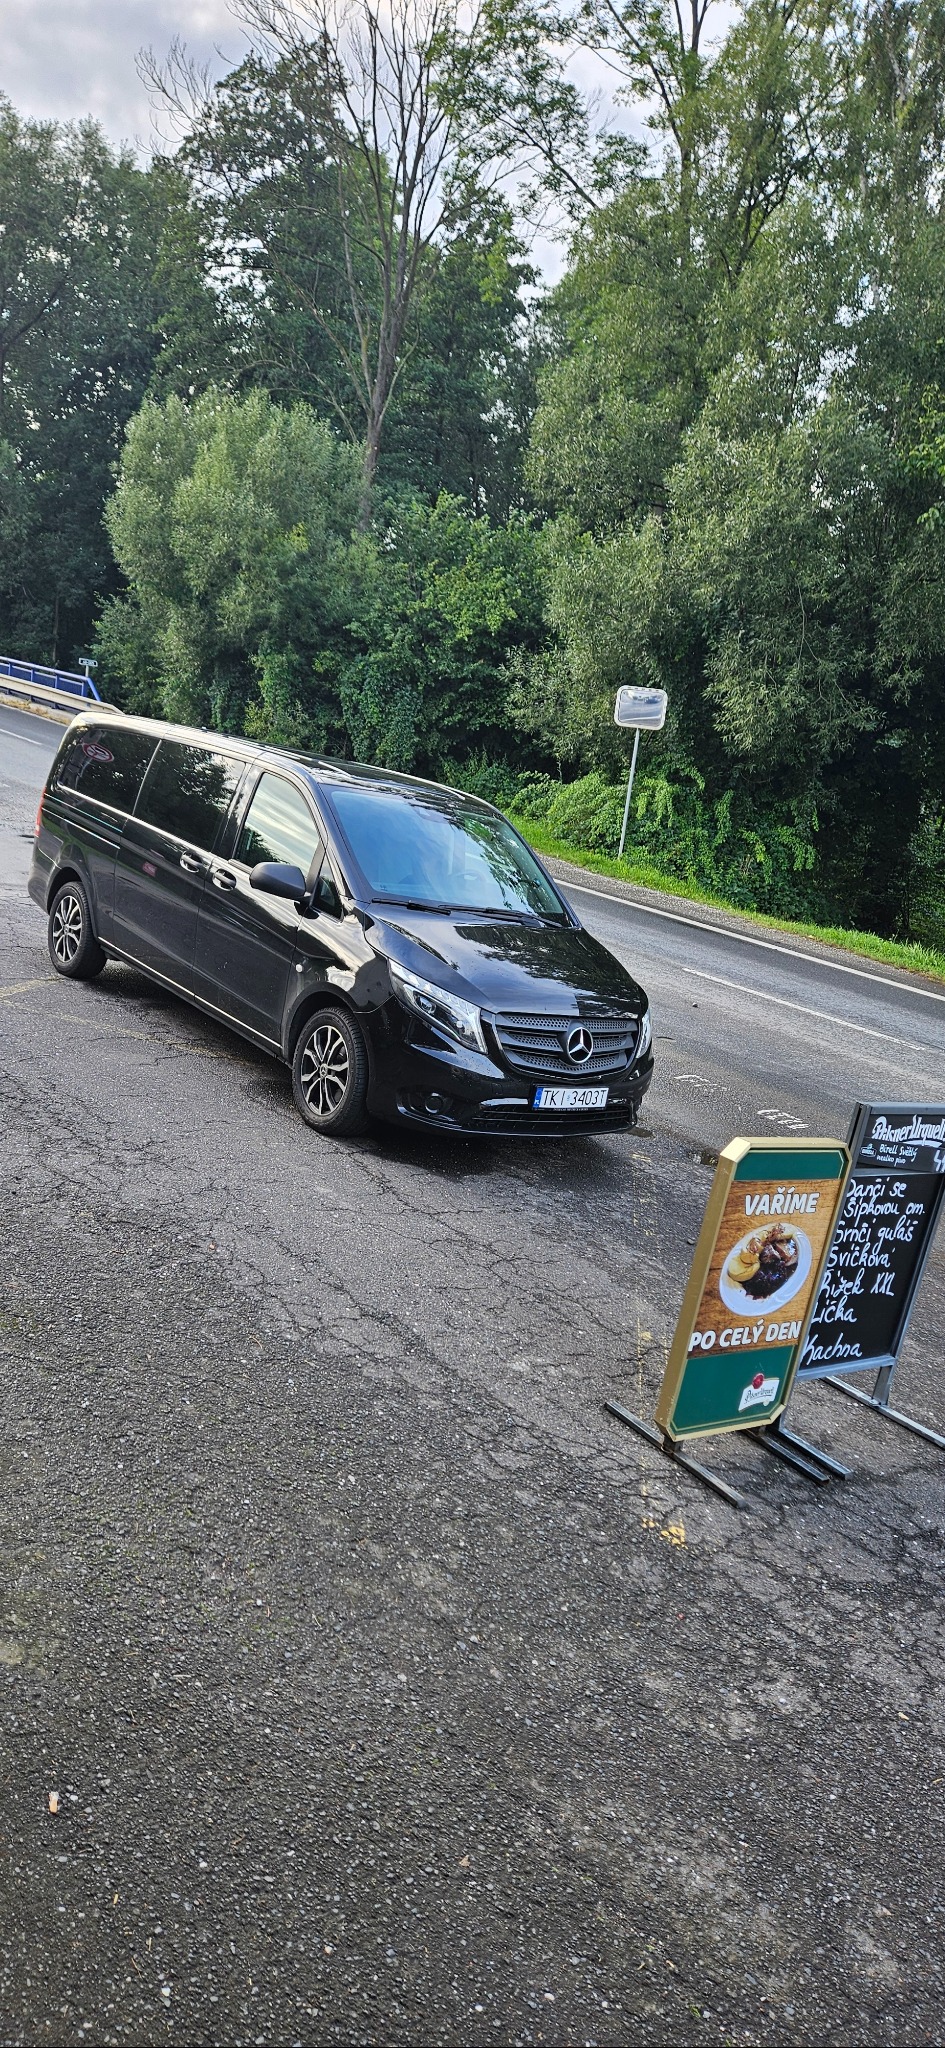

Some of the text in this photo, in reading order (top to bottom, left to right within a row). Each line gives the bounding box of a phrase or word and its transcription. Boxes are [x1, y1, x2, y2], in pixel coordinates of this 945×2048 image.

[543, 1090, 607, 1106] TKI 3403T
[872, 1116, 912, 1142] Pilsner
[744, 1186, 820, 1216] VAŘÍME
[889, 1181, 908, 1198] se
[905, 1202, 926, 1216] om.
[870, 1271, 896, 1297] XXL
[688, 1319, 803, 1352] PO CELÝ DEN
[800, 1332, 863, 1366] Kachna
